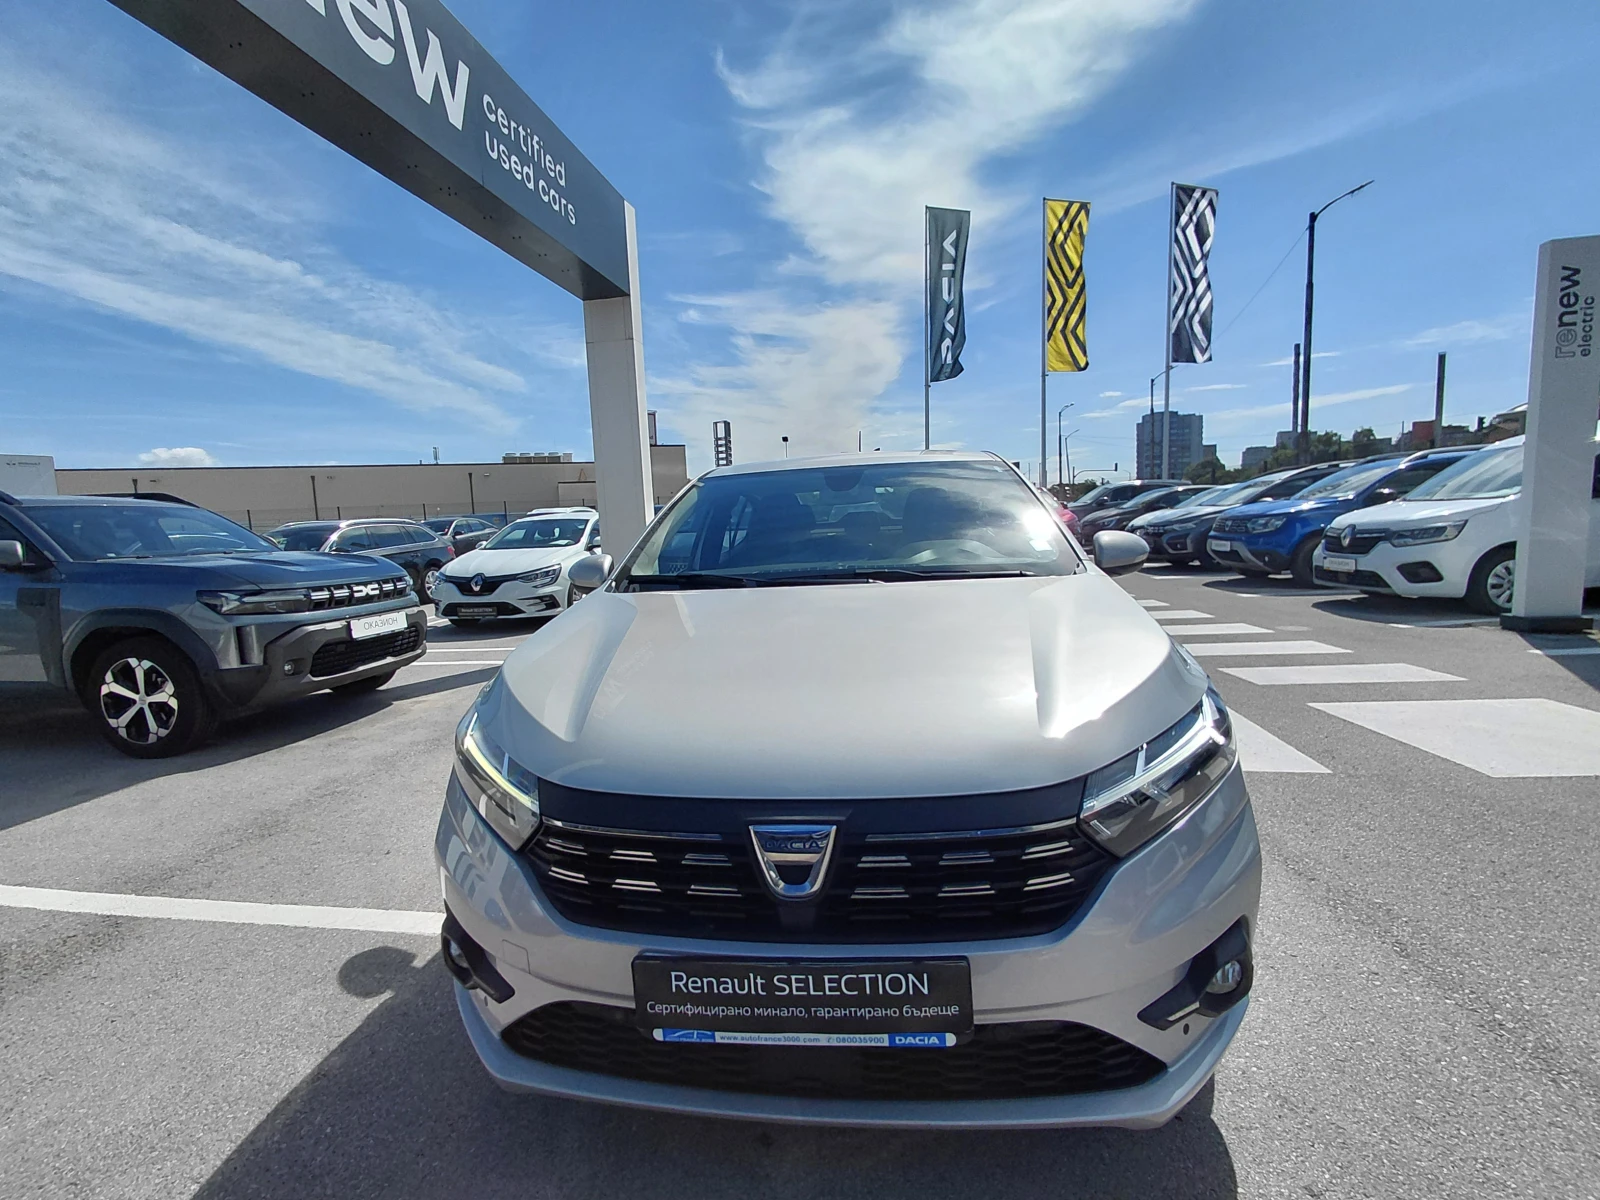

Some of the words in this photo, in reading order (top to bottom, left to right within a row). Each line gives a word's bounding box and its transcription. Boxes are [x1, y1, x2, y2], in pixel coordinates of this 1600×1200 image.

[305, 0, 470, 131] ew
[482, 93, 566, 188] certified
[485, 130, 535, 191] used
[538, 179, 576, 225] cars
[1555, 266, 1581, 358] renew
[1578, 296, 1595, 357] electric
[363, 616, 399, 631] ОКАЗИОН
[646, 1001, 751, 1018] Сертифицирано
[754, 1006, 808, 1019] минало,
[811, 1006, 900, 1020] гарантирано
[902, 1004, 960, 1017] бъдеще
[670, 971, 767, 995] Renault
[773, 972, 929, 996] SELECTION
[895, 1036, 940, 1045] DACIA
